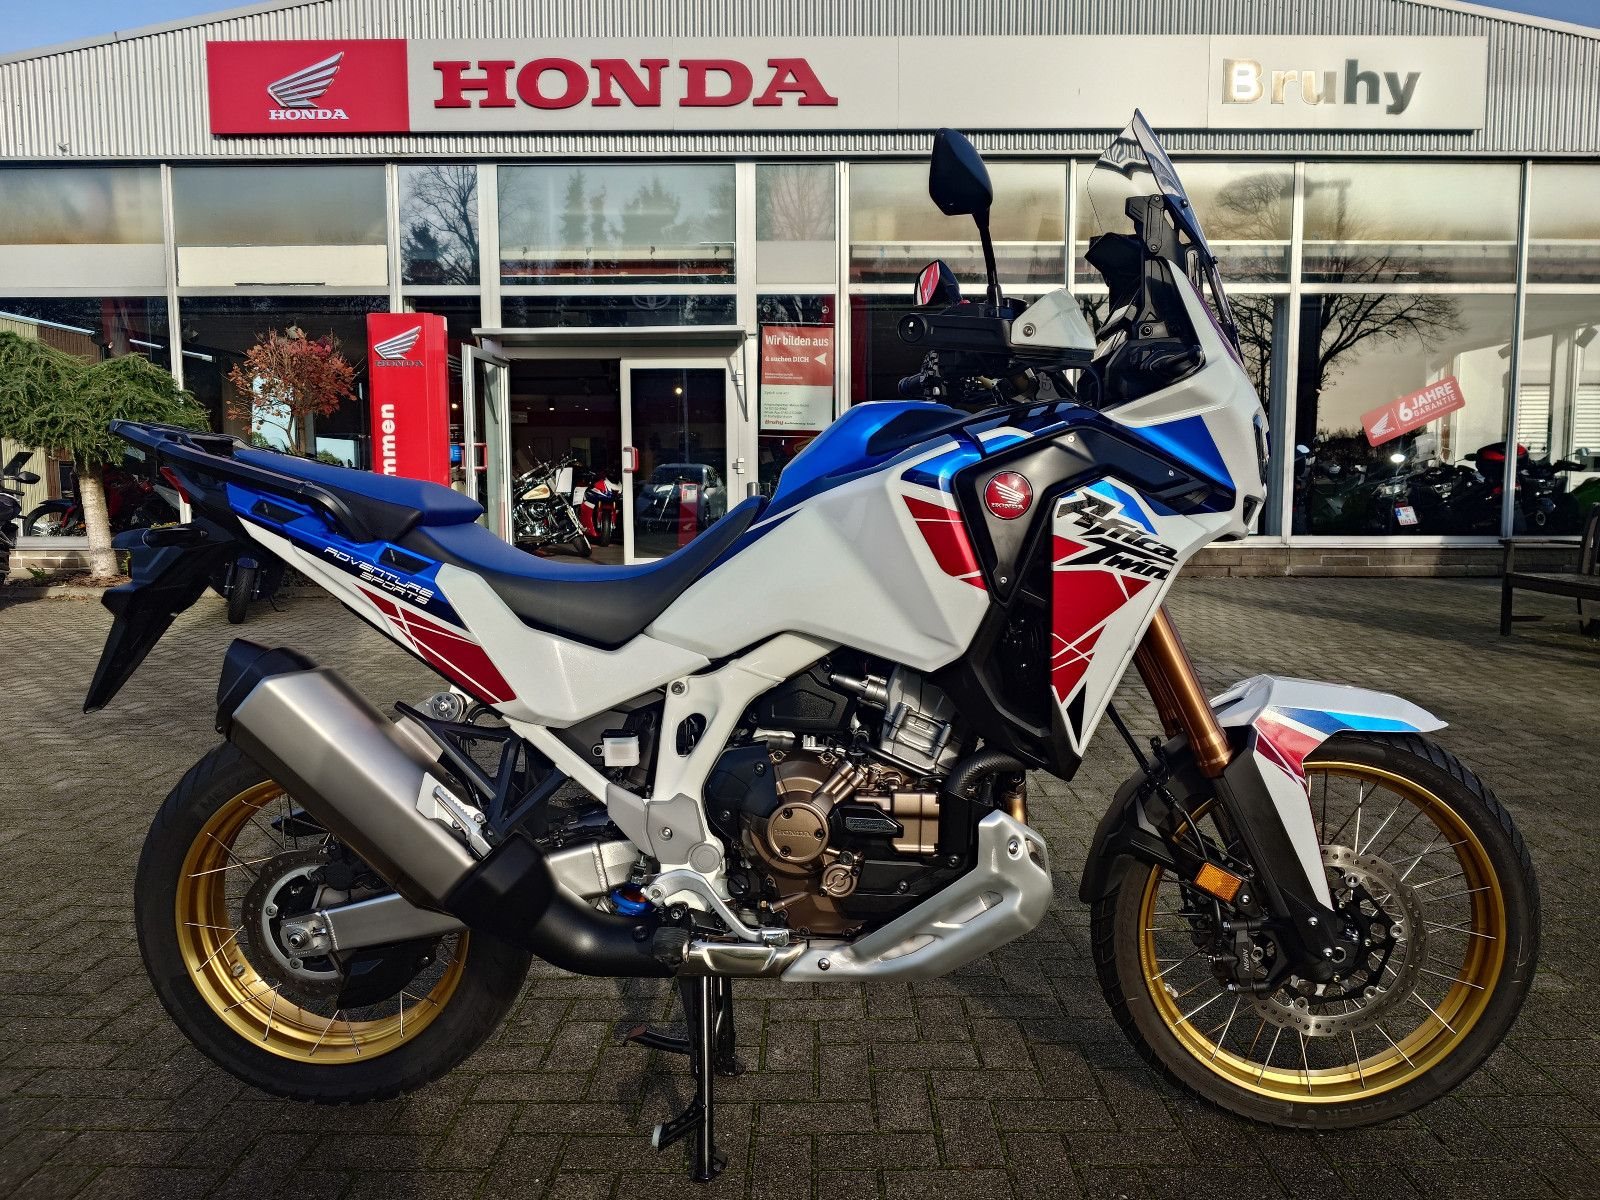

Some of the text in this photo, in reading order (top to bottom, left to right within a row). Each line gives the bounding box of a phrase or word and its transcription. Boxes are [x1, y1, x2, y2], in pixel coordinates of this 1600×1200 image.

[434, 58, 838, 110] HONDA
[1222, 59, 1421, 115] Bruhy
[268, 109, 349, 121] HONDA
[765, 335, 829, 346] Wir bilden aus
[1399, 401, 1413, 422] 6
[1413, 394, 1456, 416] GARANTIE
[991, 502, 1024, 510] HONDA
[1056, 491, 1178, 561] Africa
[324, 547, 434, 598] ADVENTURE
[1056, 536, 1176, 581] Twin
[360, 571, 430, 605] SPORTS
[774, 829, 813, 838] HONDA
